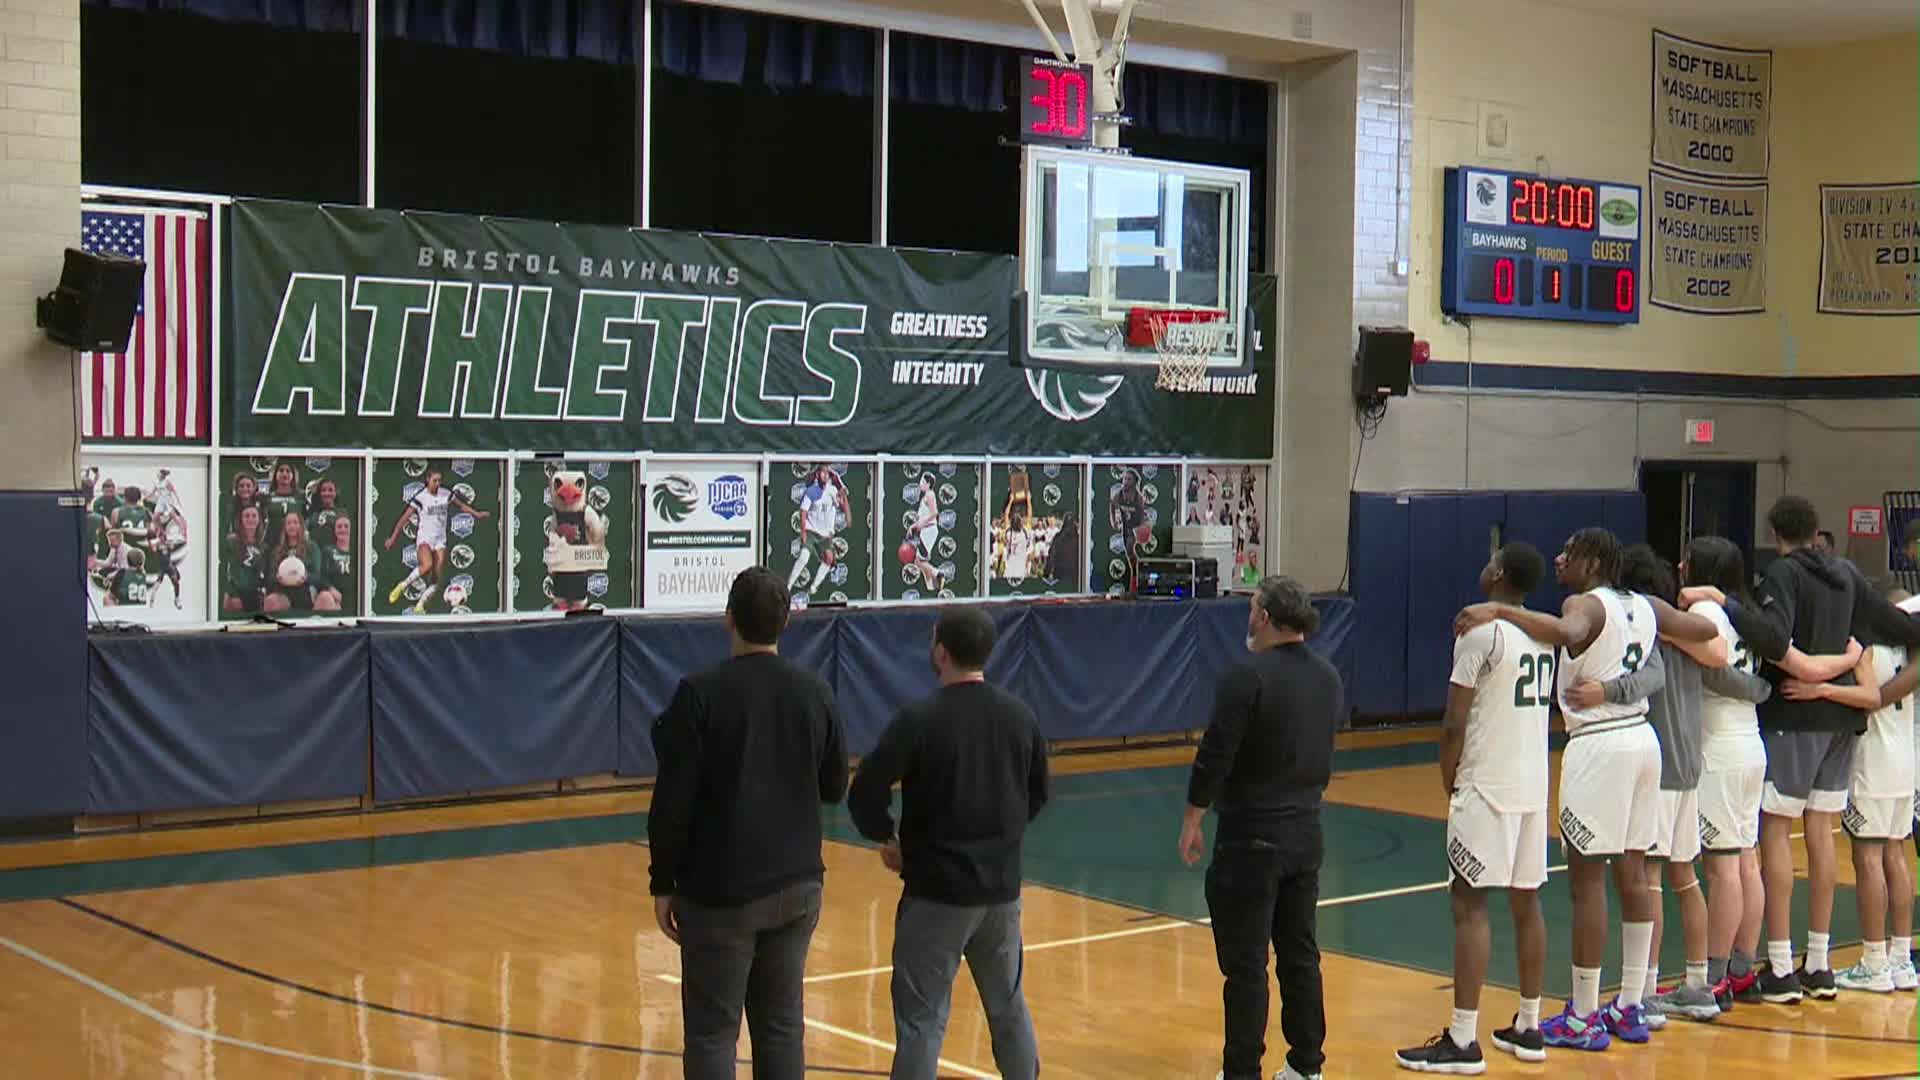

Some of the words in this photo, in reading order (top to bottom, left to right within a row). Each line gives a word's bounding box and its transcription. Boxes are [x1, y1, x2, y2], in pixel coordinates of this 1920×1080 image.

[1668, 50, 1759, 82] SOFTBALL
[1031, 67, 1087, 136] 30
[1661, 75, 1763, 110] MASSACHUSETTS
[1668, 107, 1699, 131] STATE
[1703, 114, 1756, 137] CHAMPIONS
[1688, 141, 1734, 163] 2000
[1512, 178, 1594, 230] 20:00
[1664, 190, 1754, 217] SOFTBALL
[1829, 196, 1873, 216] DIVISION
[1472, 232, 1527, 250] BAYHAWKS
[1658, 217, 1760, 243] MASSACHUSETTS
[1843, 223, 1885, 240] STATE
[1536, 247, 1568, 262] PERIOD
[1591, 240, 1633, 262] GUEST
[1665, 246, 1696, 268] STATE
[1701, 252, 1753, 272] CHAMPIONS
[417, 246, 561, 275] BRISTOL
[580, 257, 741, 286] BAYHAWKS
[1494, 257, 1515, 305] 0
[1552, 269, 1561, 300] 1
[1615, 268, 1635, 313] 0
[1686, 277, 1731, 297] 2002
[889, 311, 989, 340] GREATNESS
[251, 271, 869, 428] ATHLETICS
[892, 359, 985, 387] INTEGRITY
[707, 482, 748, 505] NJCAA
[574, 550, 605, 561] BRISTOL
[673, 556, 726, 567] BRISTOL
[1514, 653, 1554, 708] 20
[1560, 806, 1596, 851] BRISTOL
[1448, 836, 1487, 884] BRISTOL
